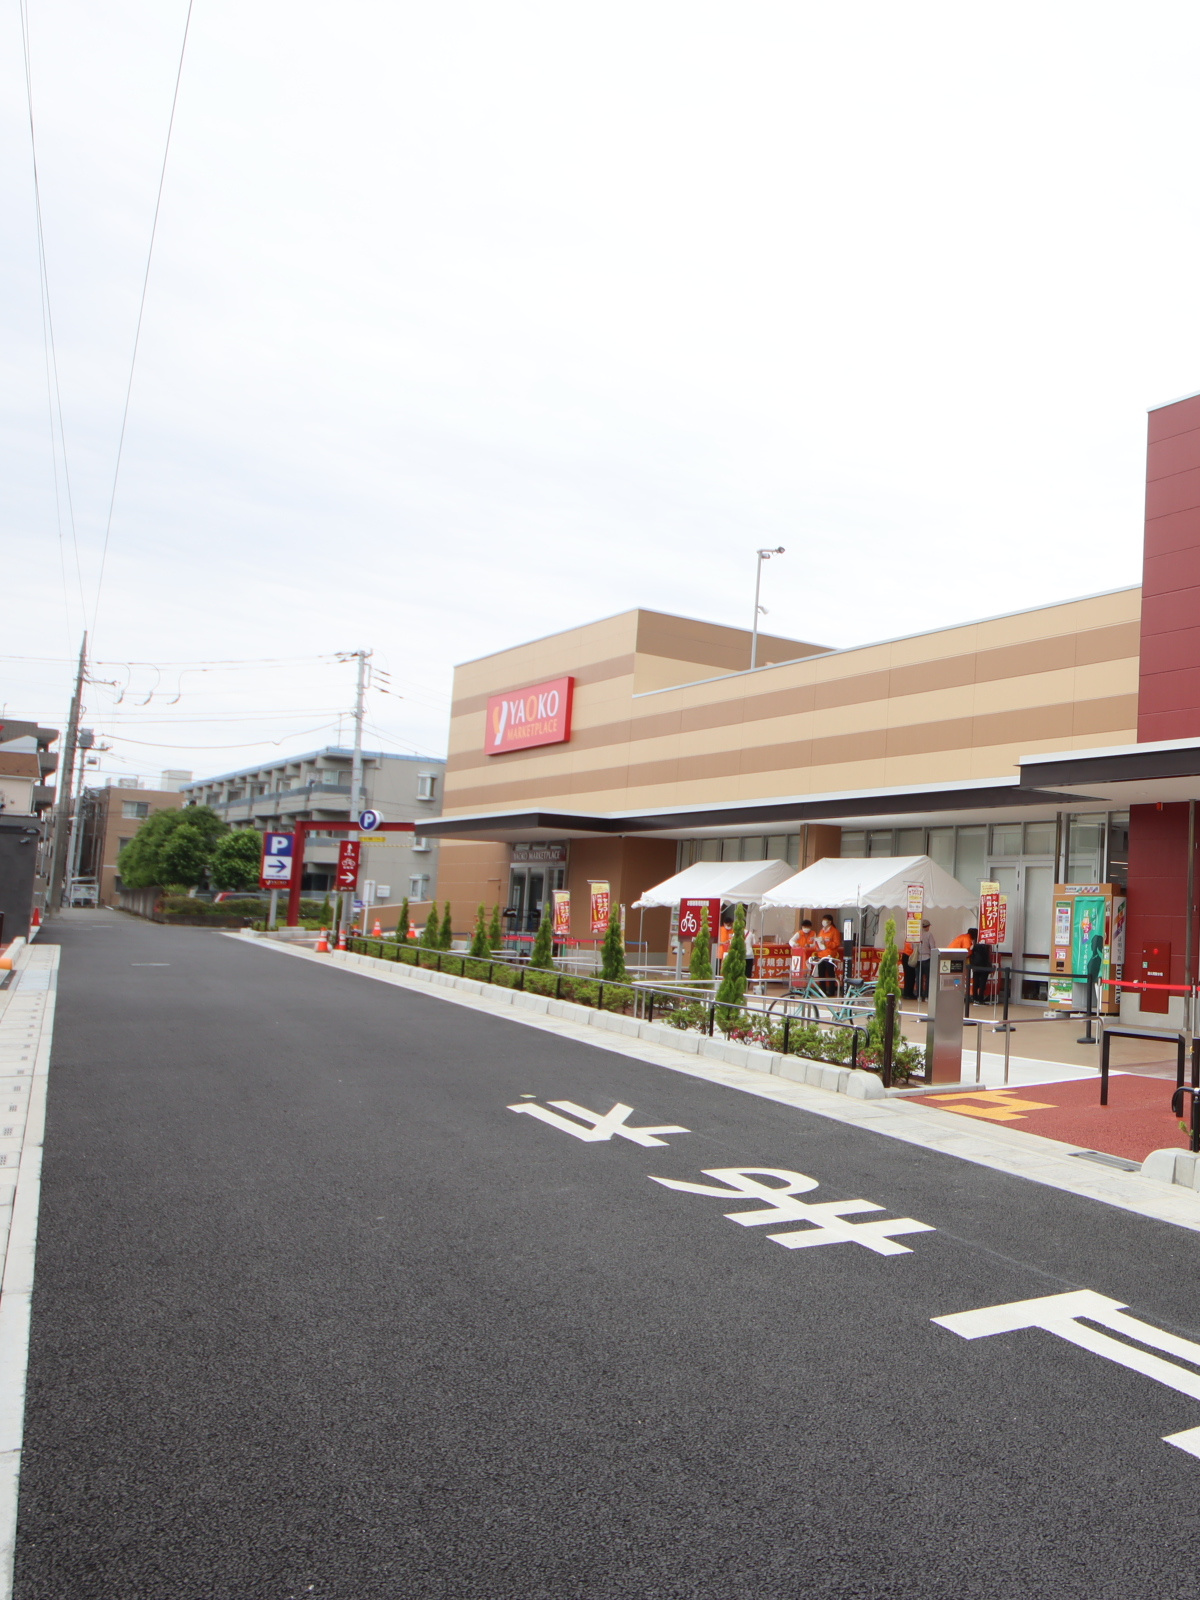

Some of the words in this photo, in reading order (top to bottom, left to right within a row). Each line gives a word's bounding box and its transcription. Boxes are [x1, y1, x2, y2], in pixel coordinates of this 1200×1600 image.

[509, 690, 559, 725] YAOKO
[507, 719, 558, 741] MARKETPLACE
[363, 813, 375, 828] P
[270, 836, 289, 855] P
[513, 851, 527, 860] YAOKO
[528, 850, 561, 860] MARKETPLACE
